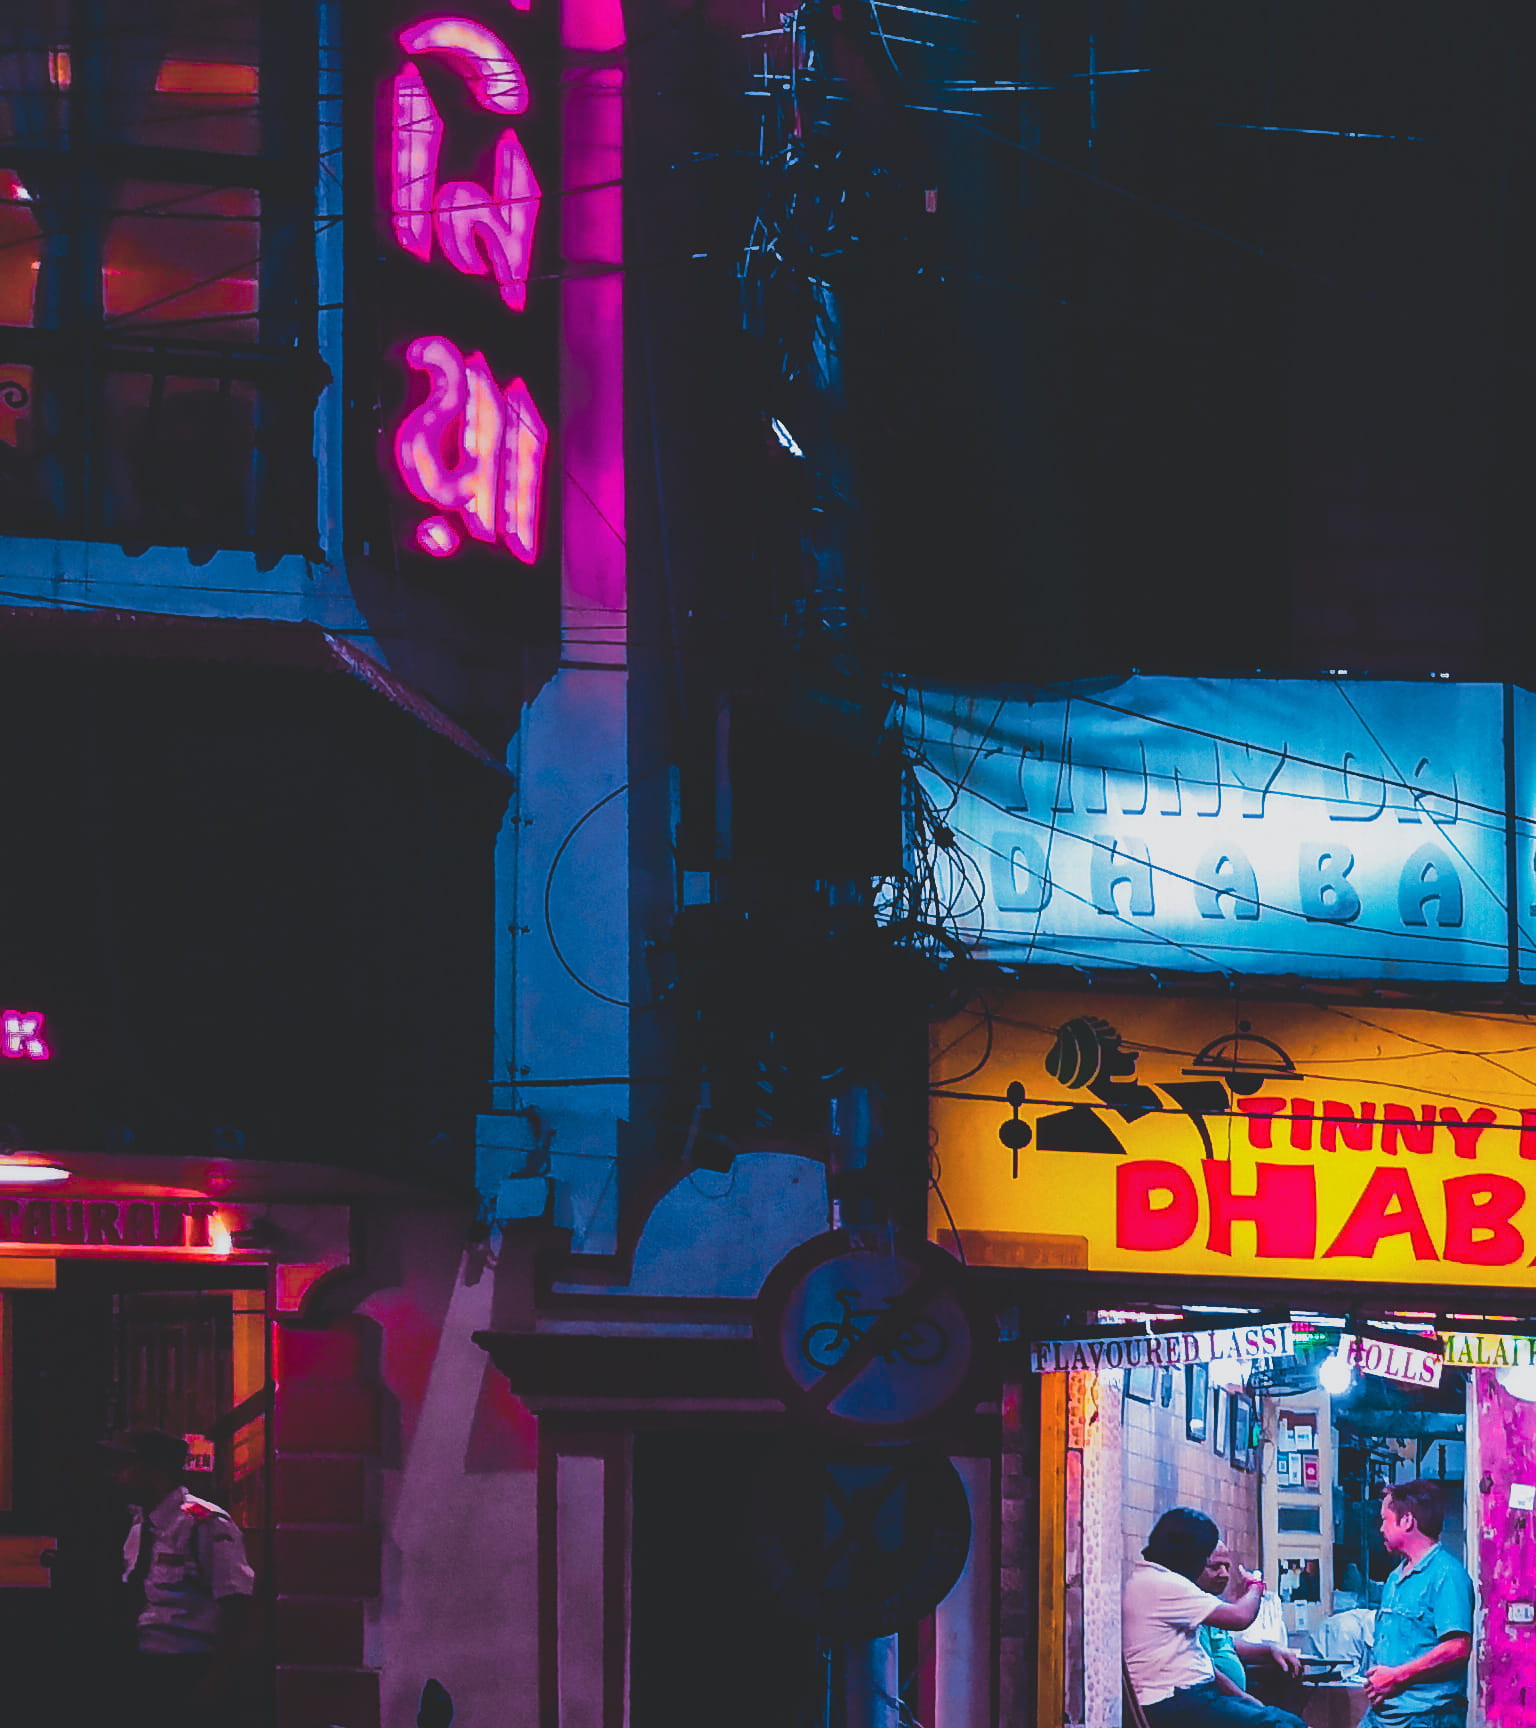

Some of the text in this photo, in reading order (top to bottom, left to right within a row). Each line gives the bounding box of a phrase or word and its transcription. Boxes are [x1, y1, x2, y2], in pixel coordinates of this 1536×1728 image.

[982, 740, 1460, 826] TINNY DA
[989, 831, 1465, 928] DHABA
[1236, 1096, 1498, 1161] TINNY
[1035, 1326, 1289, 1371] FLAVOURED LASSI
